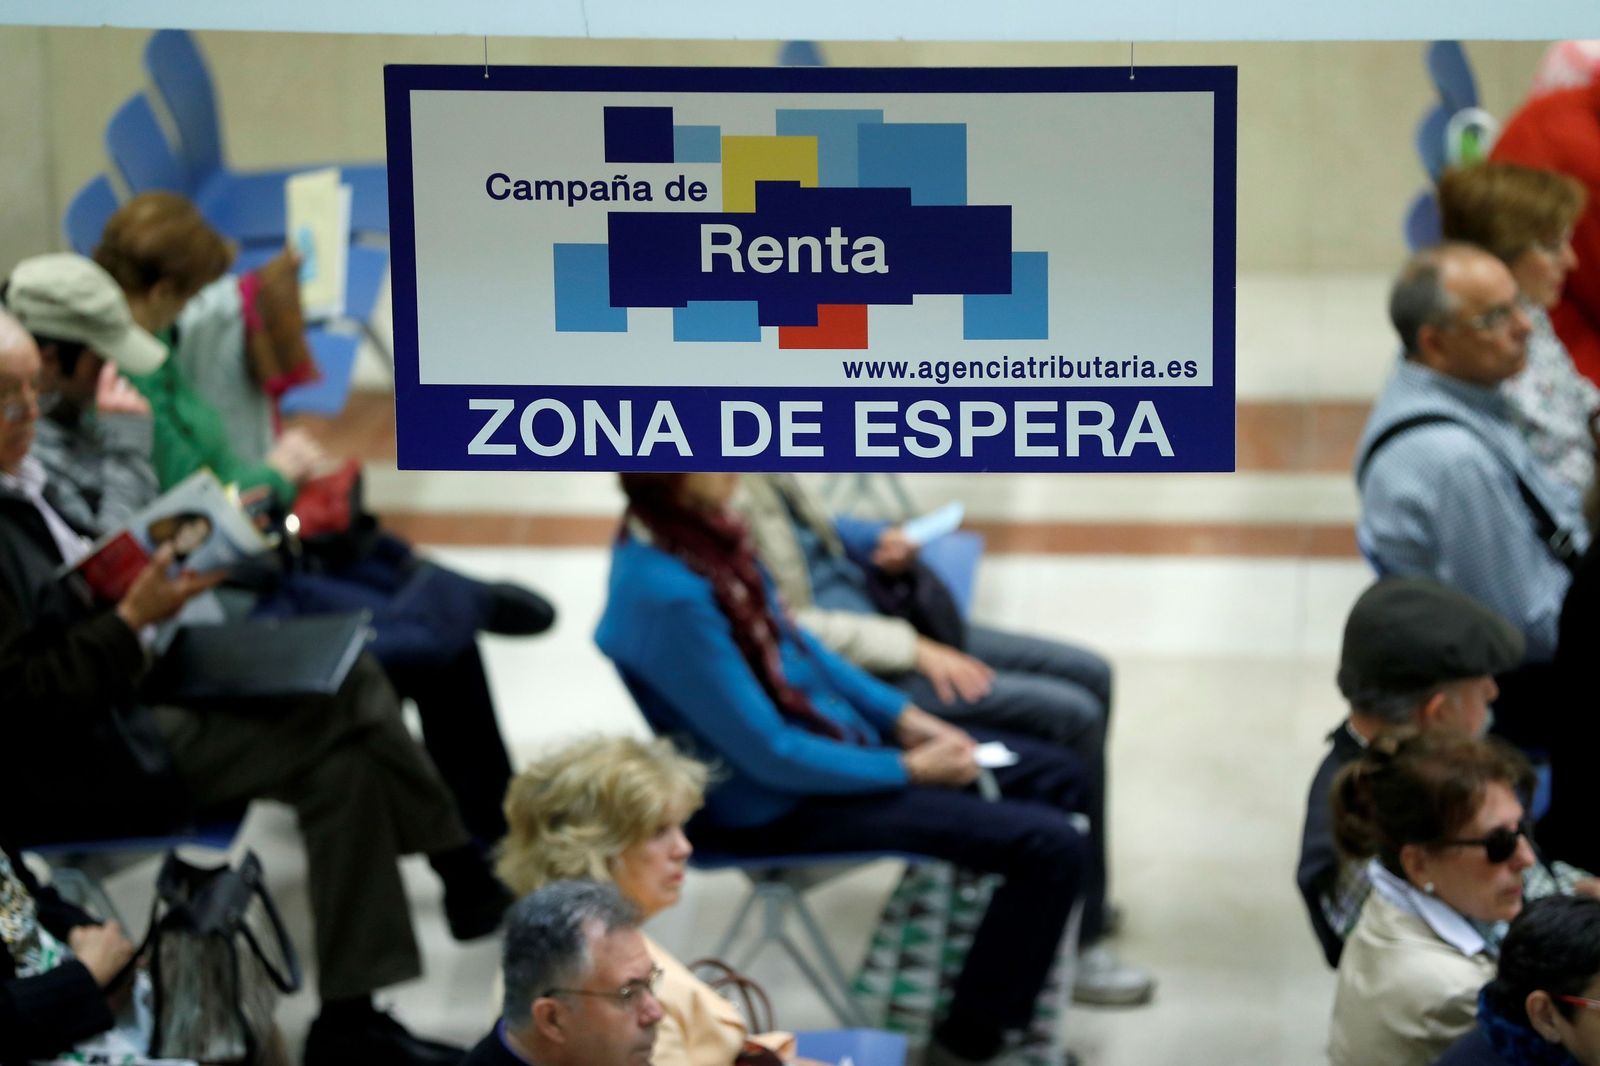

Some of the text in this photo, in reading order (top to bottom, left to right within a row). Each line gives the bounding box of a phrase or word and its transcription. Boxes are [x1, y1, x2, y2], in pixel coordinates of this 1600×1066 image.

[485, 172, 708, 207] Campaña de
[700, 223, 889, 275] Renta
[843, 355, 1198, 384] www.agenciatributaria.es
[467, 398, 1175, 459] ZONA DE ESPERA
